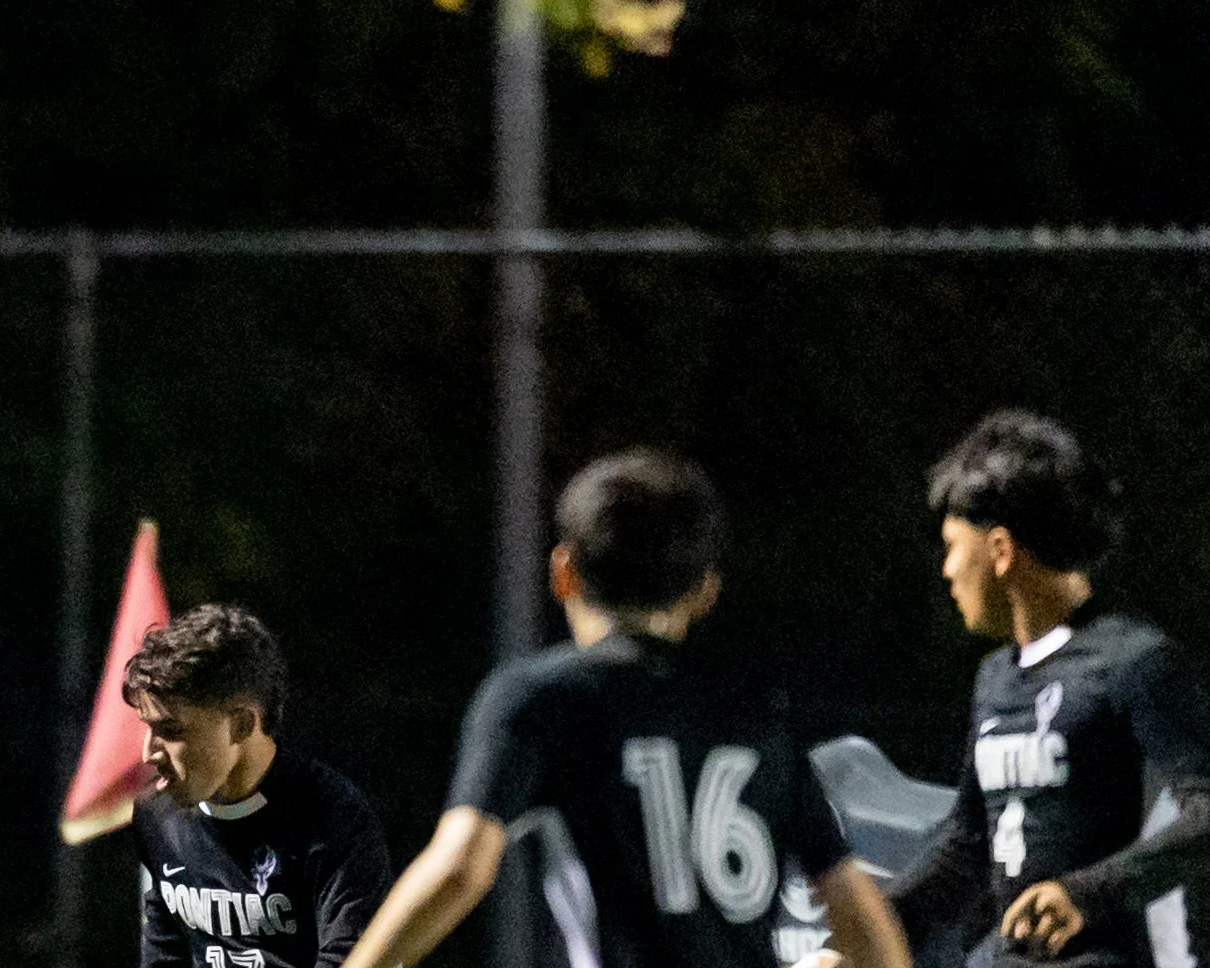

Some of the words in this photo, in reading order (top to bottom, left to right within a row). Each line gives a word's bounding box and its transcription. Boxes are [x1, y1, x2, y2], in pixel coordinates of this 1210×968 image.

[622, 736, 778, 923] 16
[993, 798, 1026, 878] 4
[160, 881, 297, 936] PONTIAC
